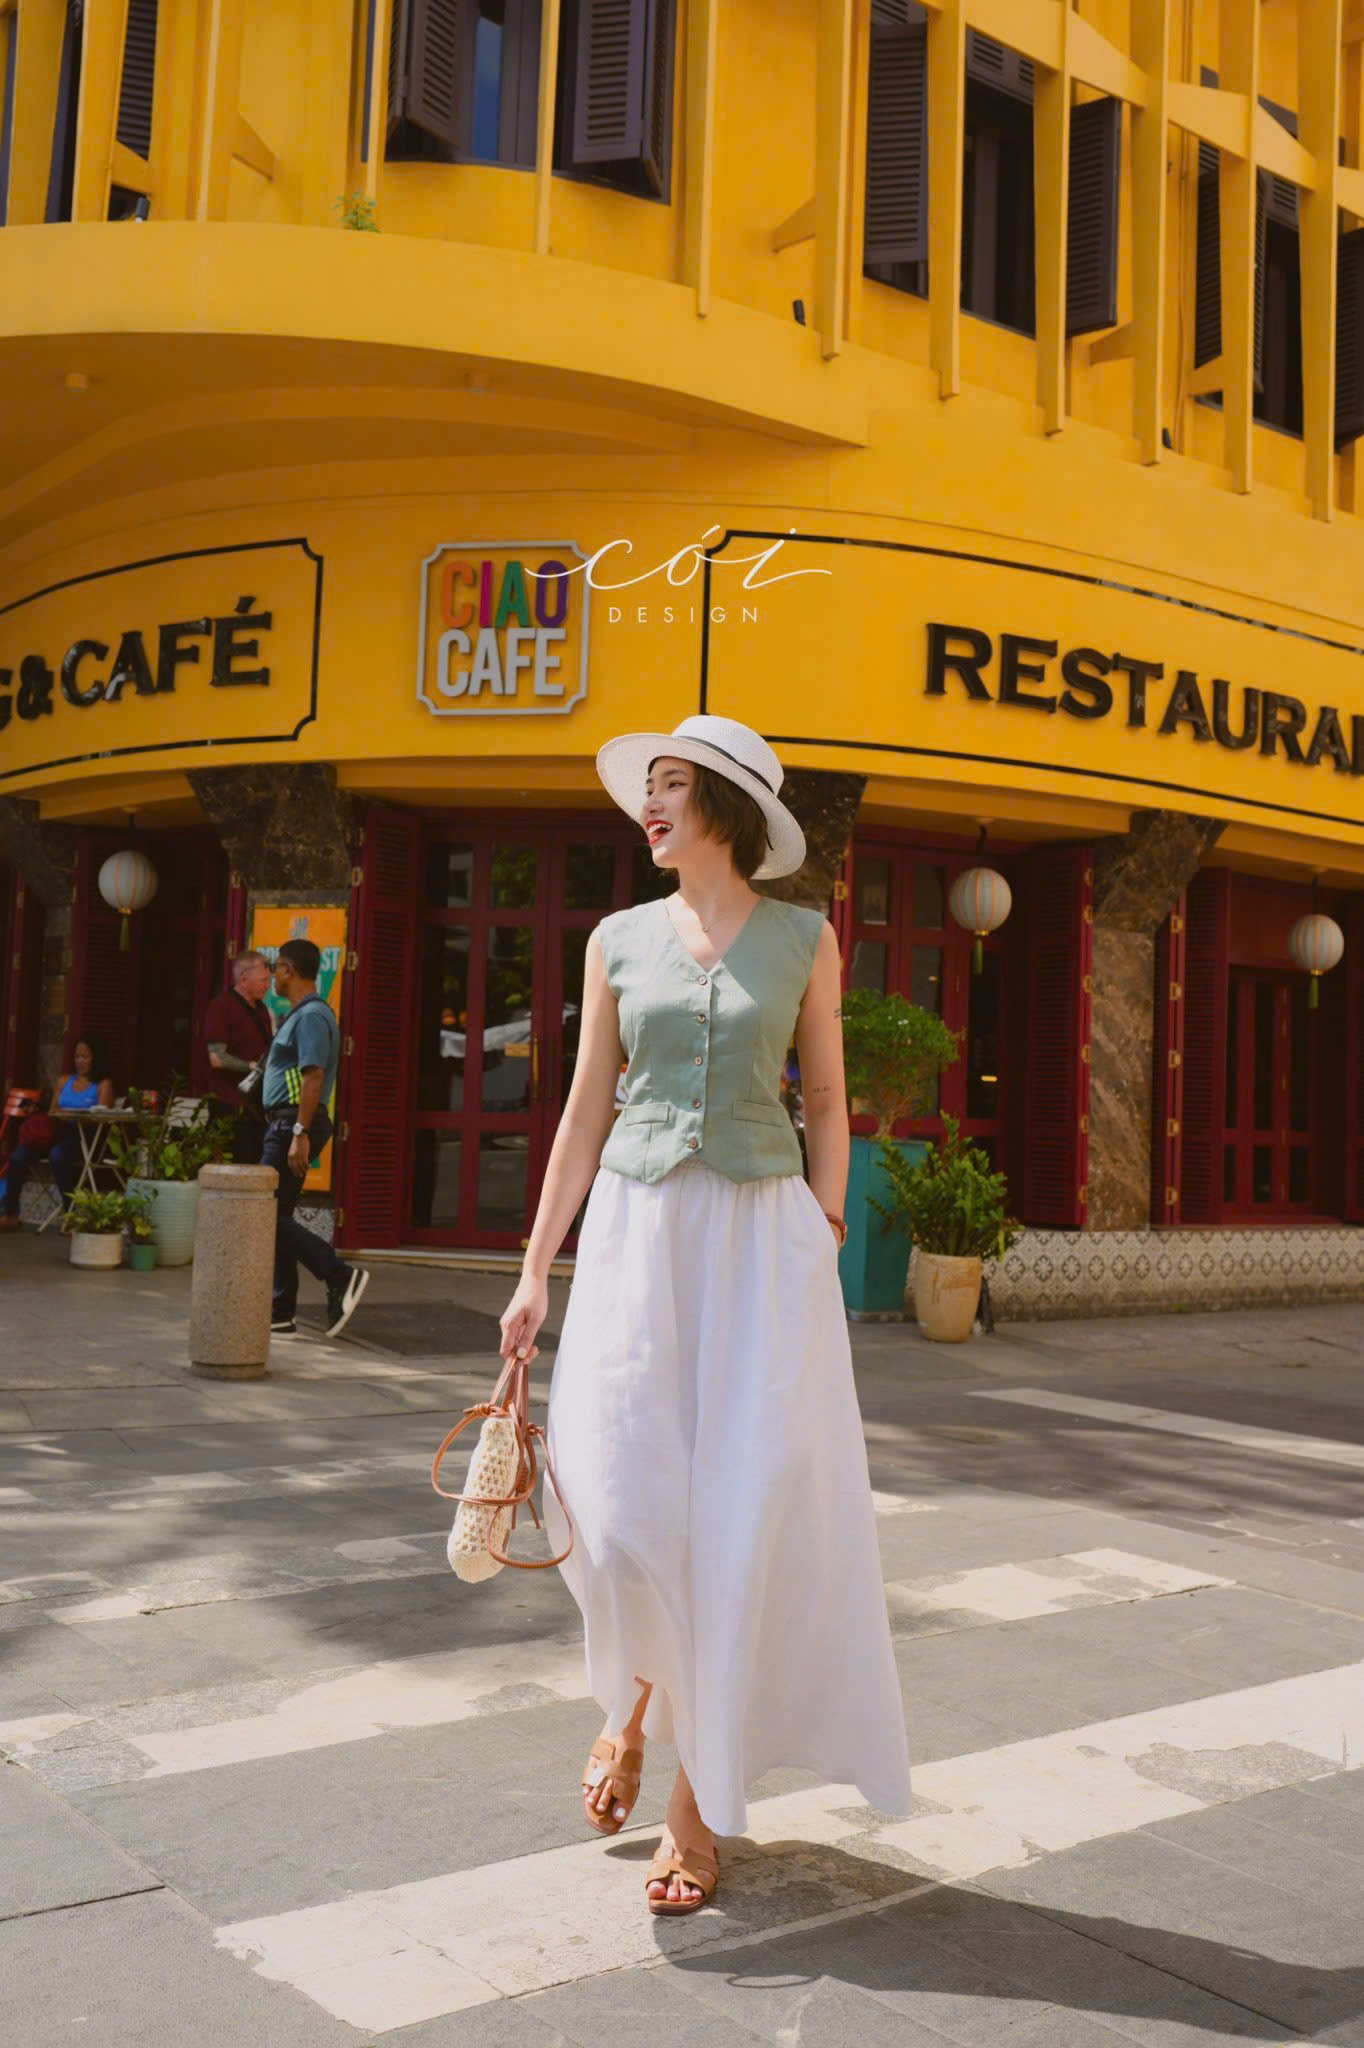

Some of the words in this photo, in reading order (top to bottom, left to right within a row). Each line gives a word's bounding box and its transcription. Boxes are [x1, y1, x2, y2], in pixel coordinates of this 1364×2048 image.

[443, 560, 568, 628] CIAO
[438, 627, 566, 697] CAFE
[924, 622, 1364, 774] RESTAURA
